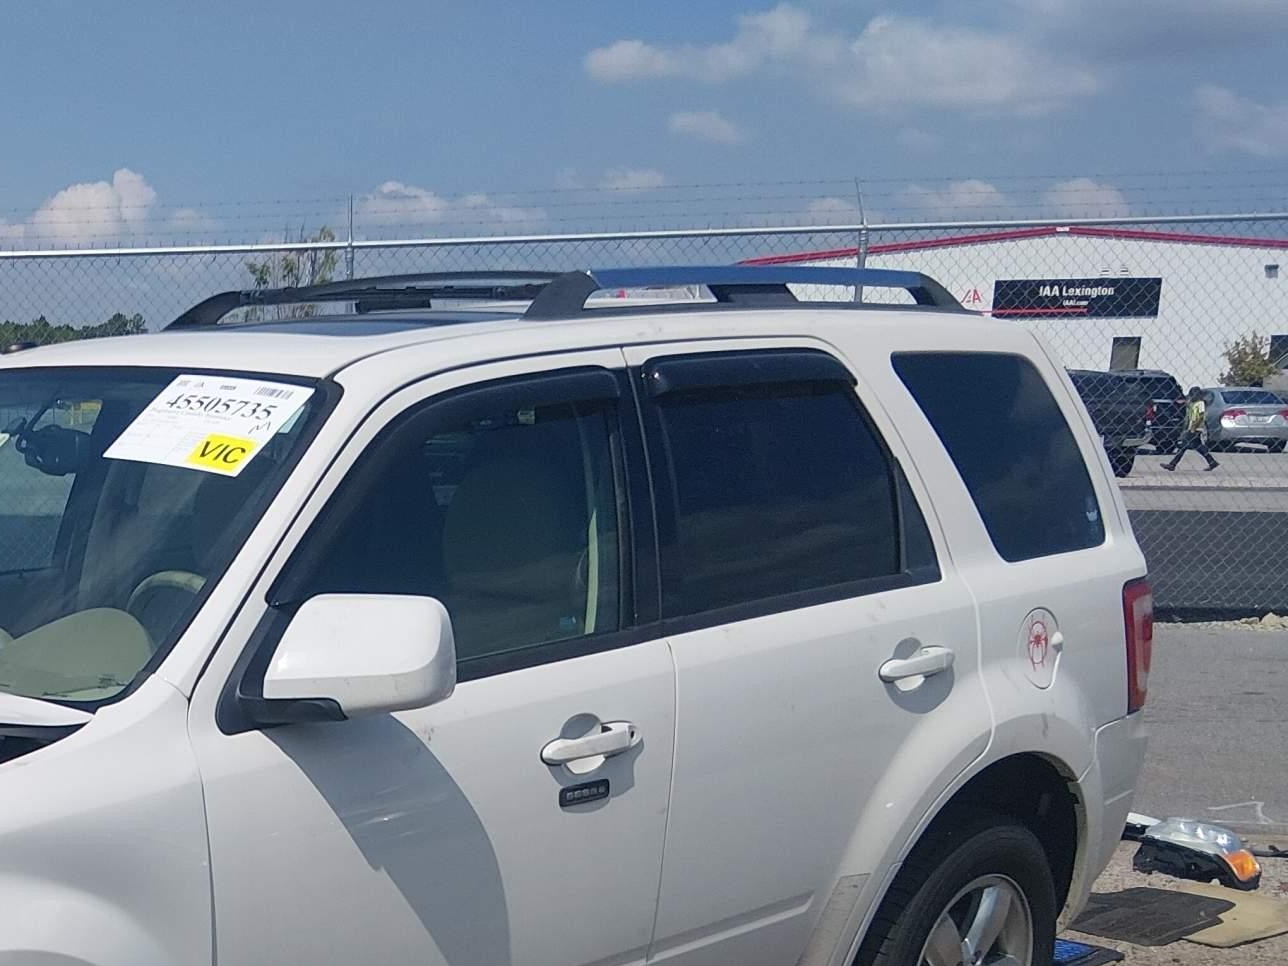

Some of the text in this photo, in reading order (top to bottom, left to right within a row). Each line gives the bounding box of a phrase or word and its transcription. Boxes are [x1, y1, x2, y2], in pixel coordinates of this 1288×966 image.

[1038, 285, 1115, 298] IAA Lexington
[165, 393, 278, 421] 45505735
[199, 441, 246, 464] VIC
